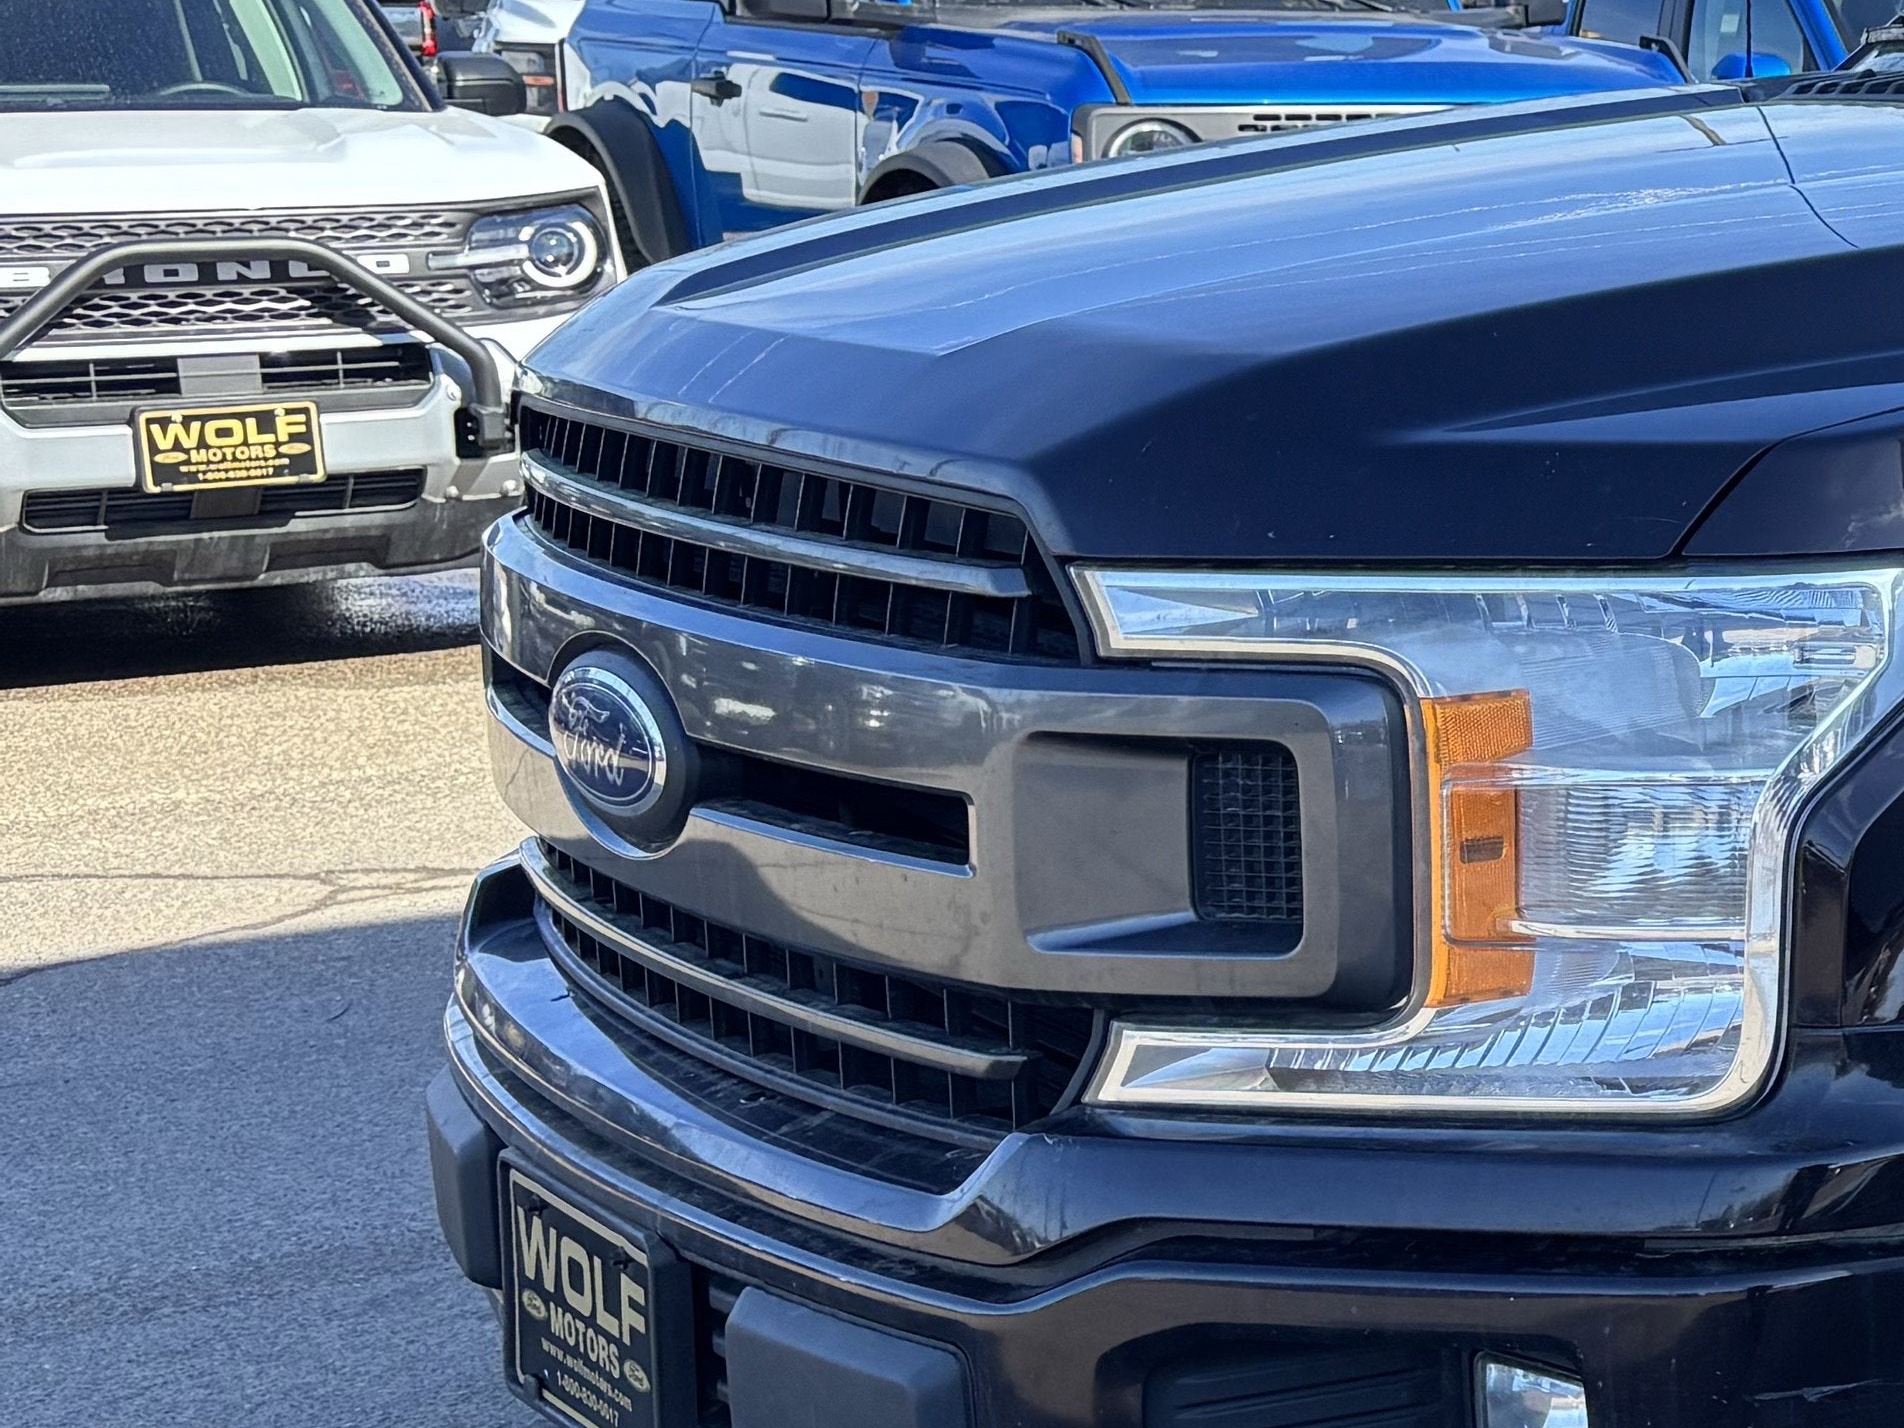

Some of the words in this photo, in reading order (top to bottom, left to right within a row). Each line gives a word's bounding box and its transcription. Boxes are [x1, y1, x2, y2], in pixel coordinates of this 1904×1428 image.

[150, 414, 307, 450] WOLF
[190, 444, 277, 463] MOTORS
[562, 689, 627, 787] Ford
[516, 1206, 646, 1346] WOLF
[550, 1302, 620, 1379] MOTORS
